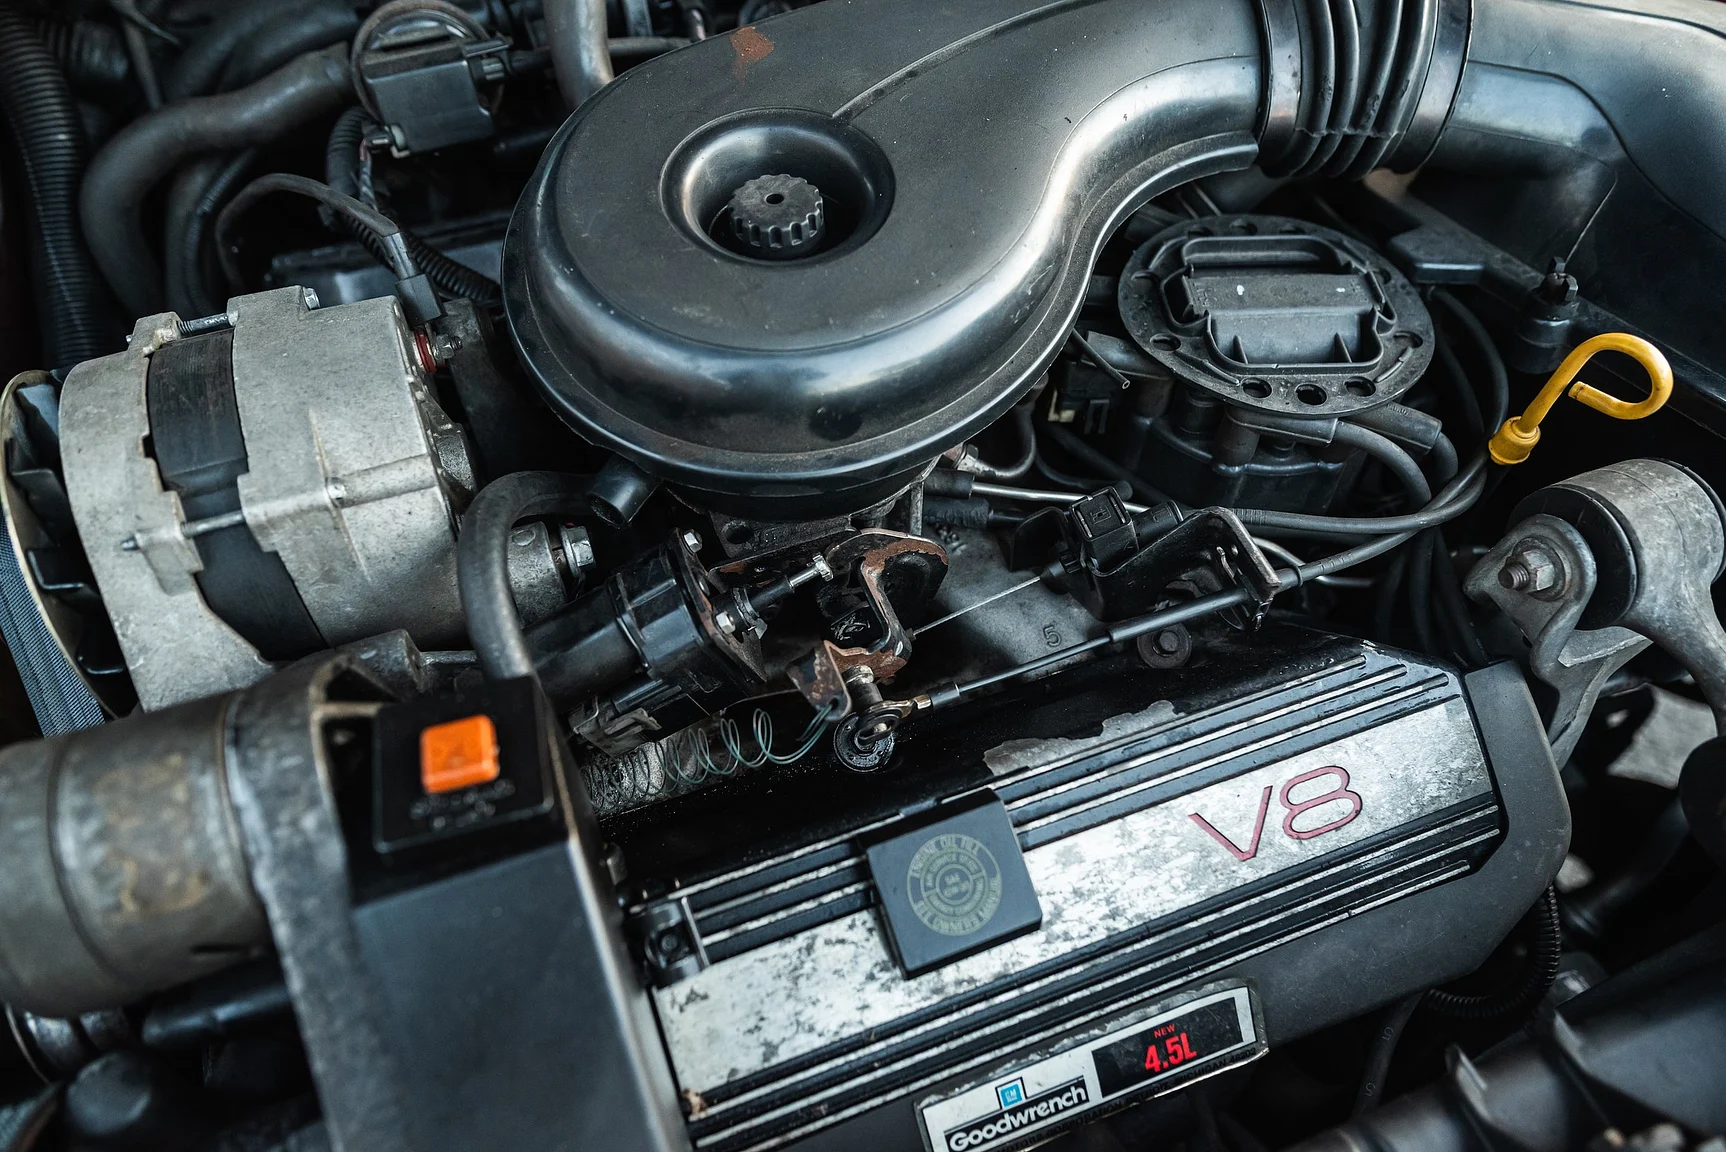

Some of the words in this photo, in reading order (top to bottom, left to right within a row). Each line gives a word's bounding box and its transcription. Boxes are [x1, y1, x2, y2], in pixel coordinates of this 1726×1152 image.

[1042, 623, 1063, 648] 5
[1187, 765, 1364, 863] V8
[1154, 1024, 1175, 1038] NEW
[1145, 1032, 1197, 1073] 4.5L
[949, 1086, 1087, 1151] Goodwrench
